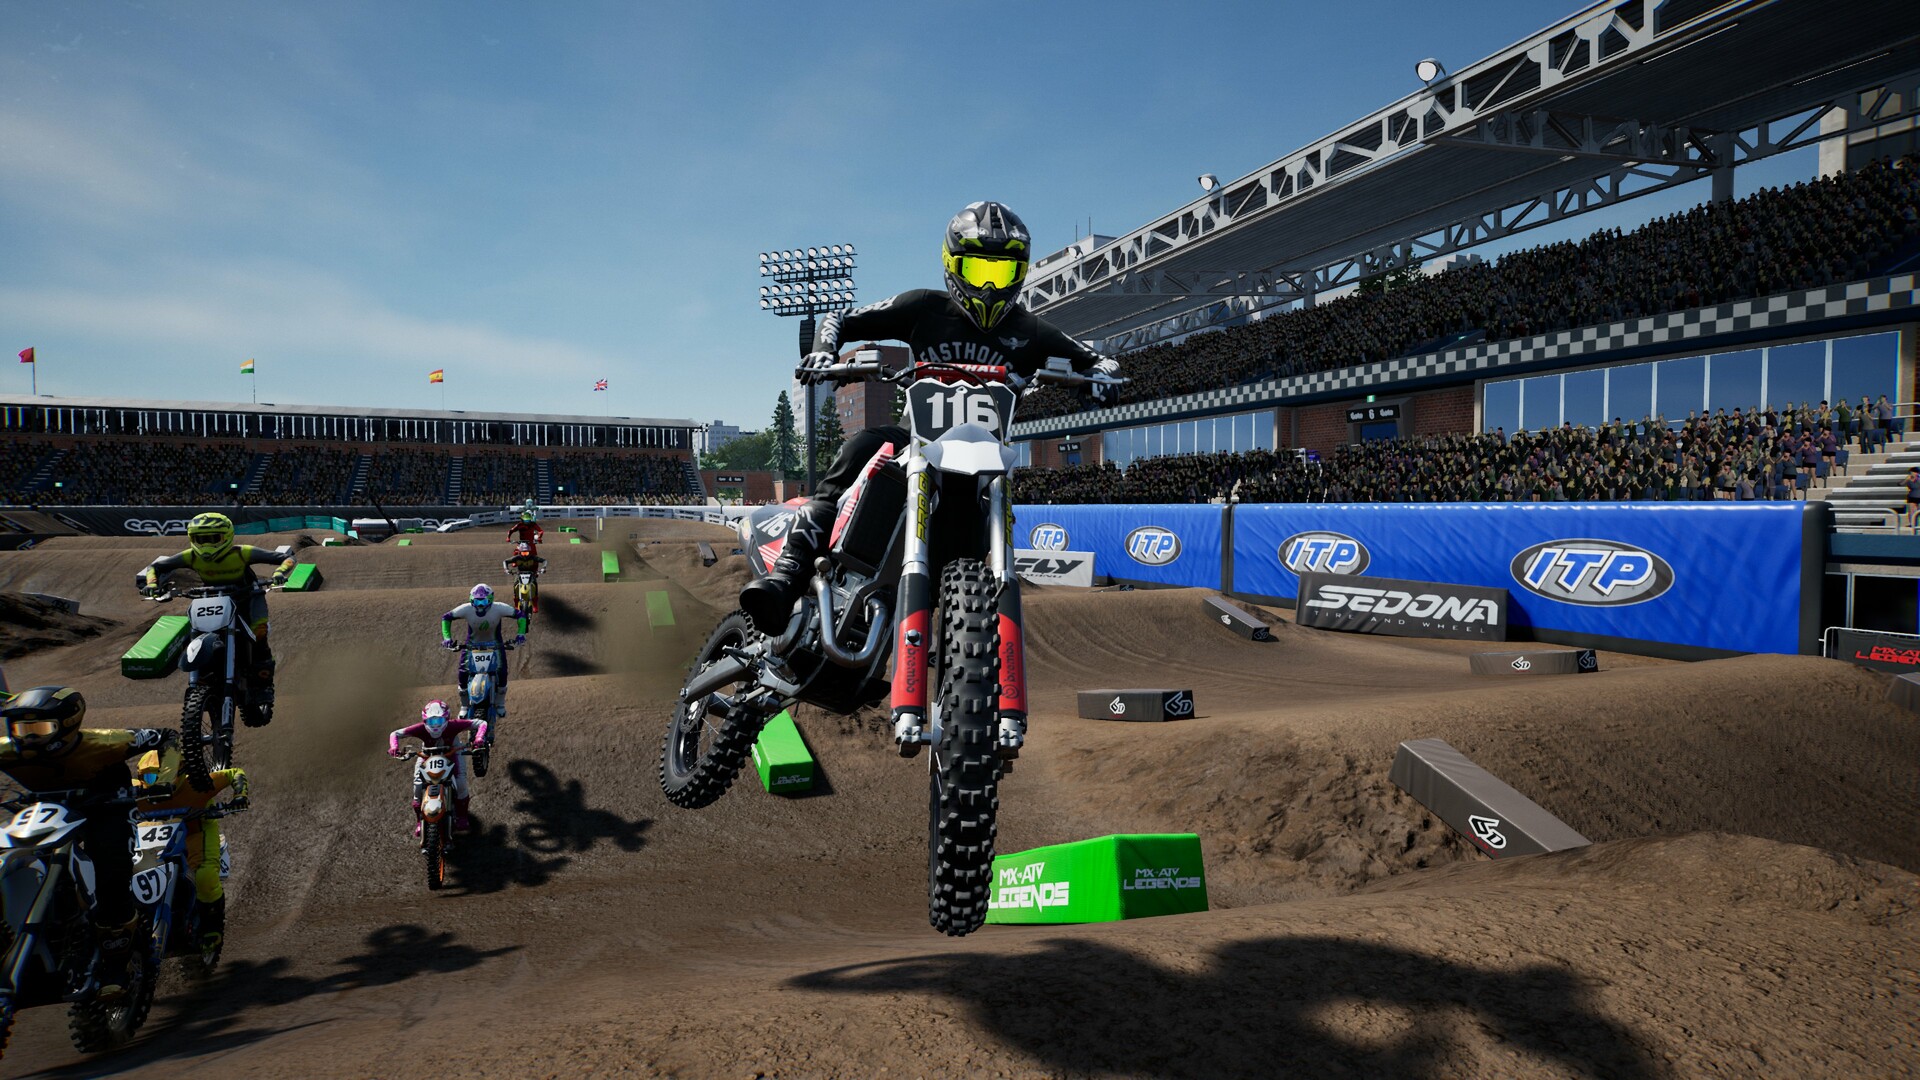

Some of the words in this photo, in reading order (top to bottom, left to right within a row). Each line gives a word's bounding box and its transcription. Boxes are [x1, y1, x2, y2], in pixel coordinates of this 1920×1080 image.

[926, 392, 999, 432] 116
[1033, 528, 1065, 550] ITP
[1129, 532, 1175, 559] ITP
[1014, 558, 1084, 574] FLY
[1286, 538, 1359, 573] ITP
[1524, 548, 1653, 596] ITP
[197, 605, 223, 617] 252
[1314, 610, 1354, 620] TIRE
[1371, 616, 1405, 625] AND
[1422, 622, 1485, 633] WHEEL
[475, 655, 491, 663] 904
[906, 647, 920, 693] brembo
[1003, 642, 1016, 682] brembo
[429, 759, 444, 769] 119
[141, 826, 173, 842] 43
[1000, 867, 1018, 886] MX
[1021, 862, 1045, 884] ATV
[1123, 876, 1201, 890] LEGENDS
[1135, 868, 1155, 878] MX
[1158, 867, 1180, 877] ATV
[136, 868, 161, 902] 97
[988, 881, 1069, 912] LEGENDS
